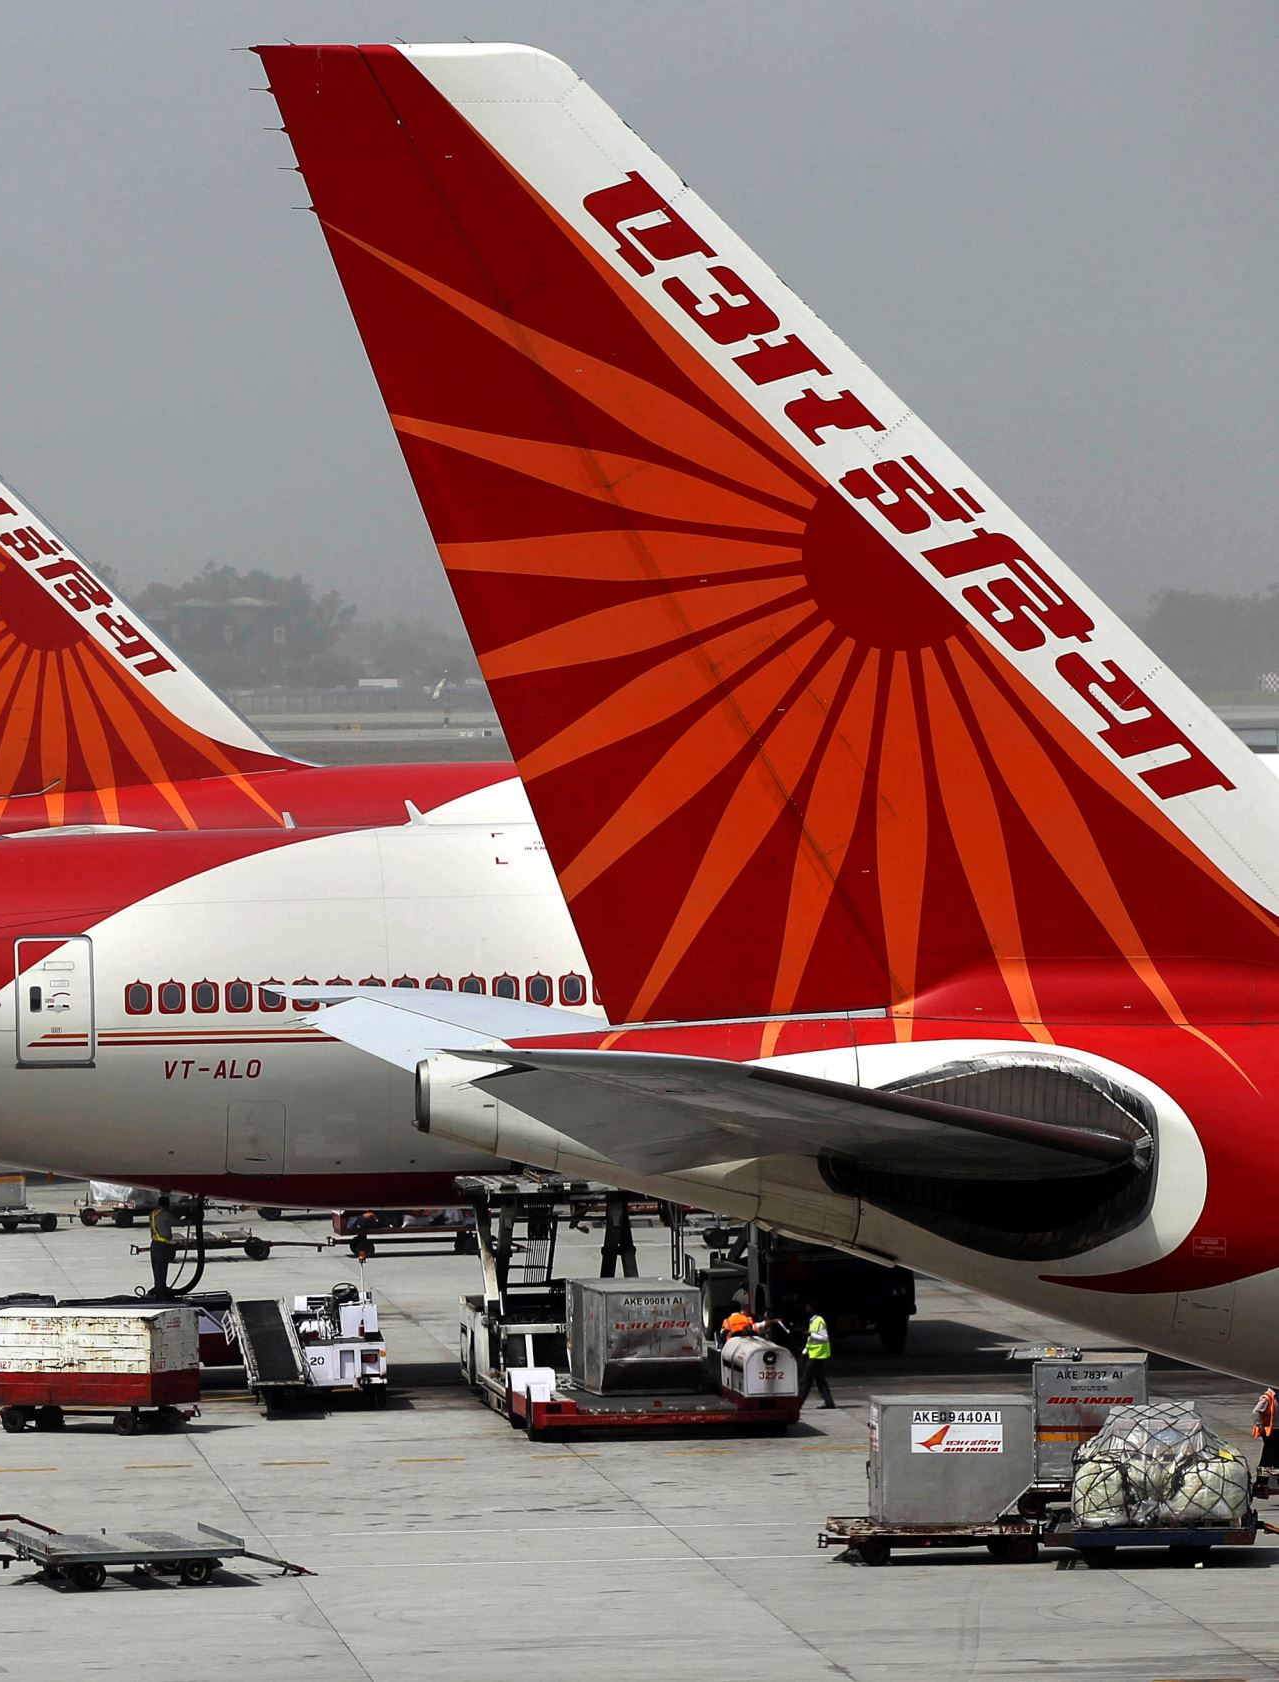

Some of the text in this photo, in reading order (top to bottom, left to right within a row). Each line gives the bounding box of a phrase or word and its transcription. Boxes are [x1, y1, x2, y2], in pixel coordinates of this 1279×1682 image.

[839, 454, 1237, 800] इंडिया
[164, 1059, 263, 1080] VT-ALO
[624, 1296, 683, 1306] AKE 09081 AI
[310, 1356, 325, 1366] 20
[1056, 1370, 1123, 1379] AKE 7837 AI
[1046, 1396, 1135, 1405] AIR-INDIA
